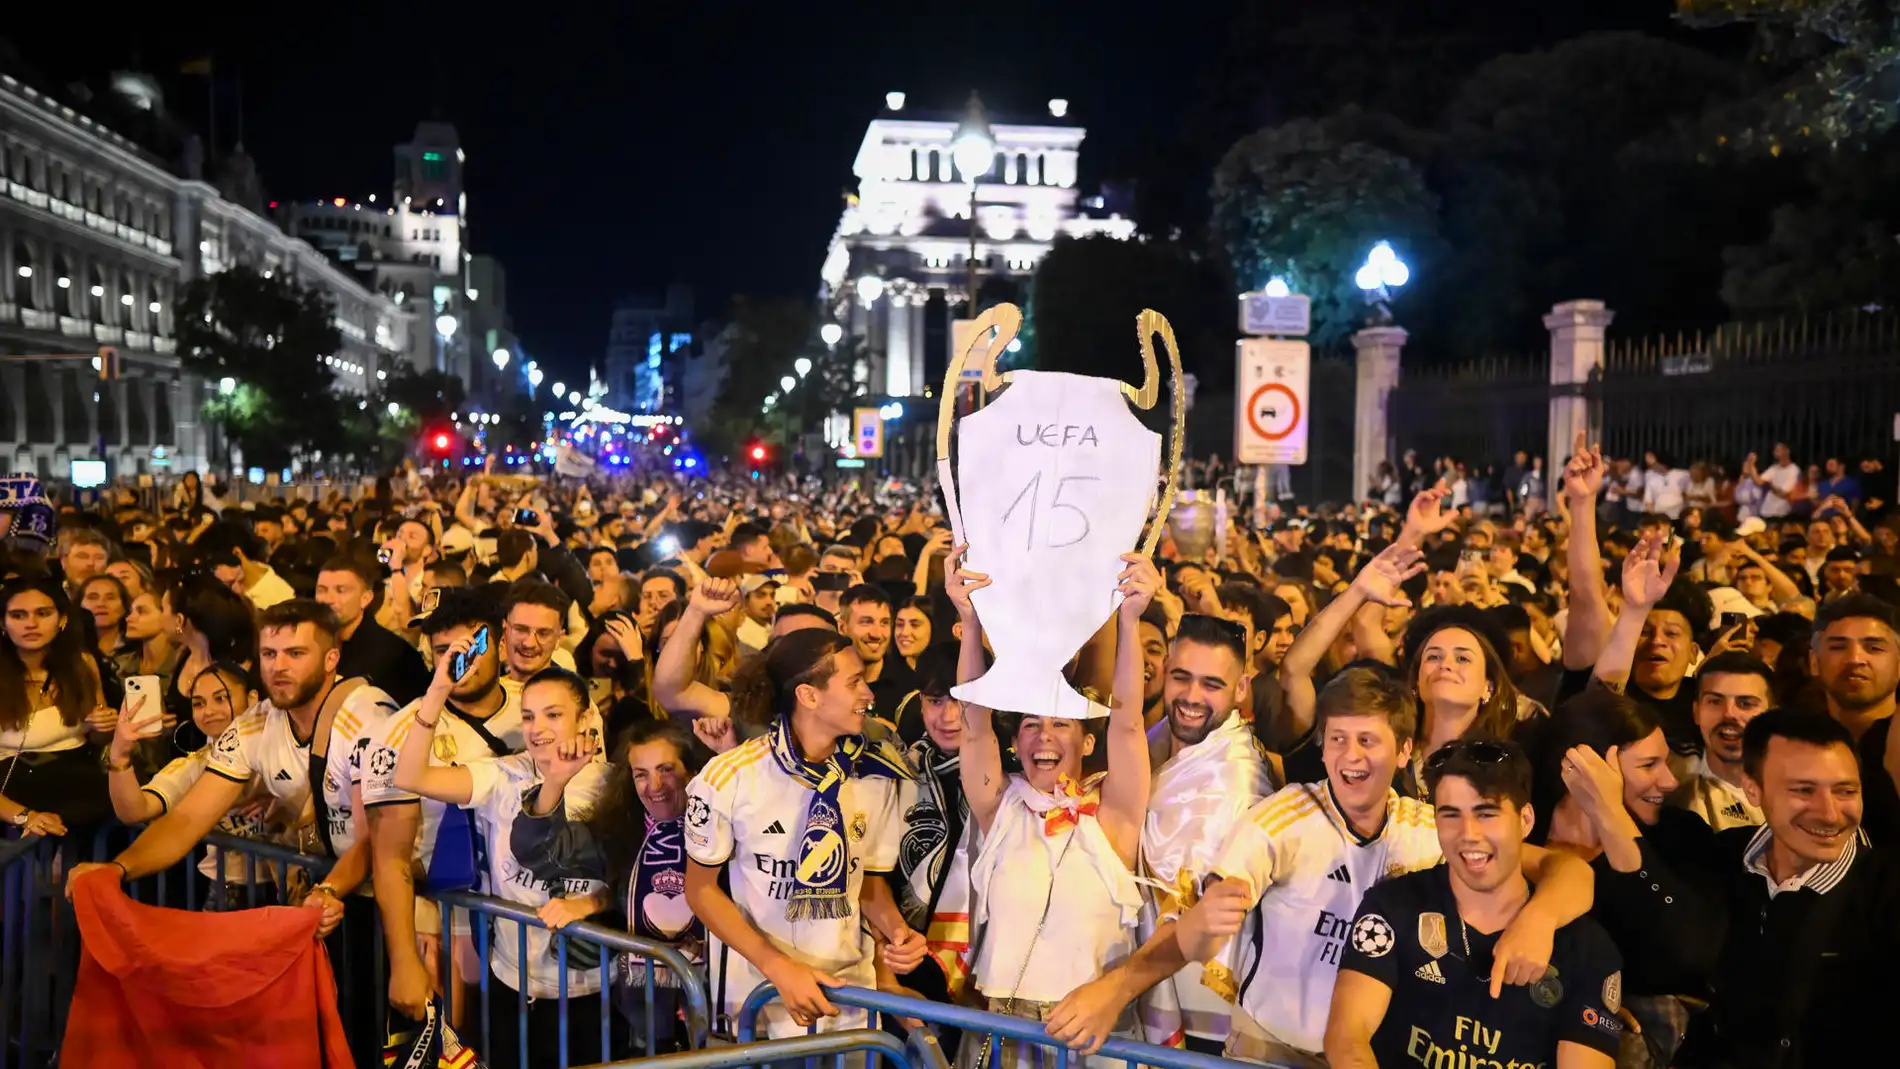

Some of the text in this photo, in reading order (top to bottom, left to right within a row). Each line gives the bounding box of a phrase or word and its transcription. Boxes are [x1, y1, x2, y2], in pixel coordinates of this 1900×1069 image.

[1017, 424, 1098, 447] UEFA
[1001, 470, 1101, 551] 15
[768, 881, 793, 900] FLY
[1415, 970, 1446, 985] adidas
[1407, 1025, 1547, 1069] Emir
[1455, 1015, 1501, 1054] Fly
